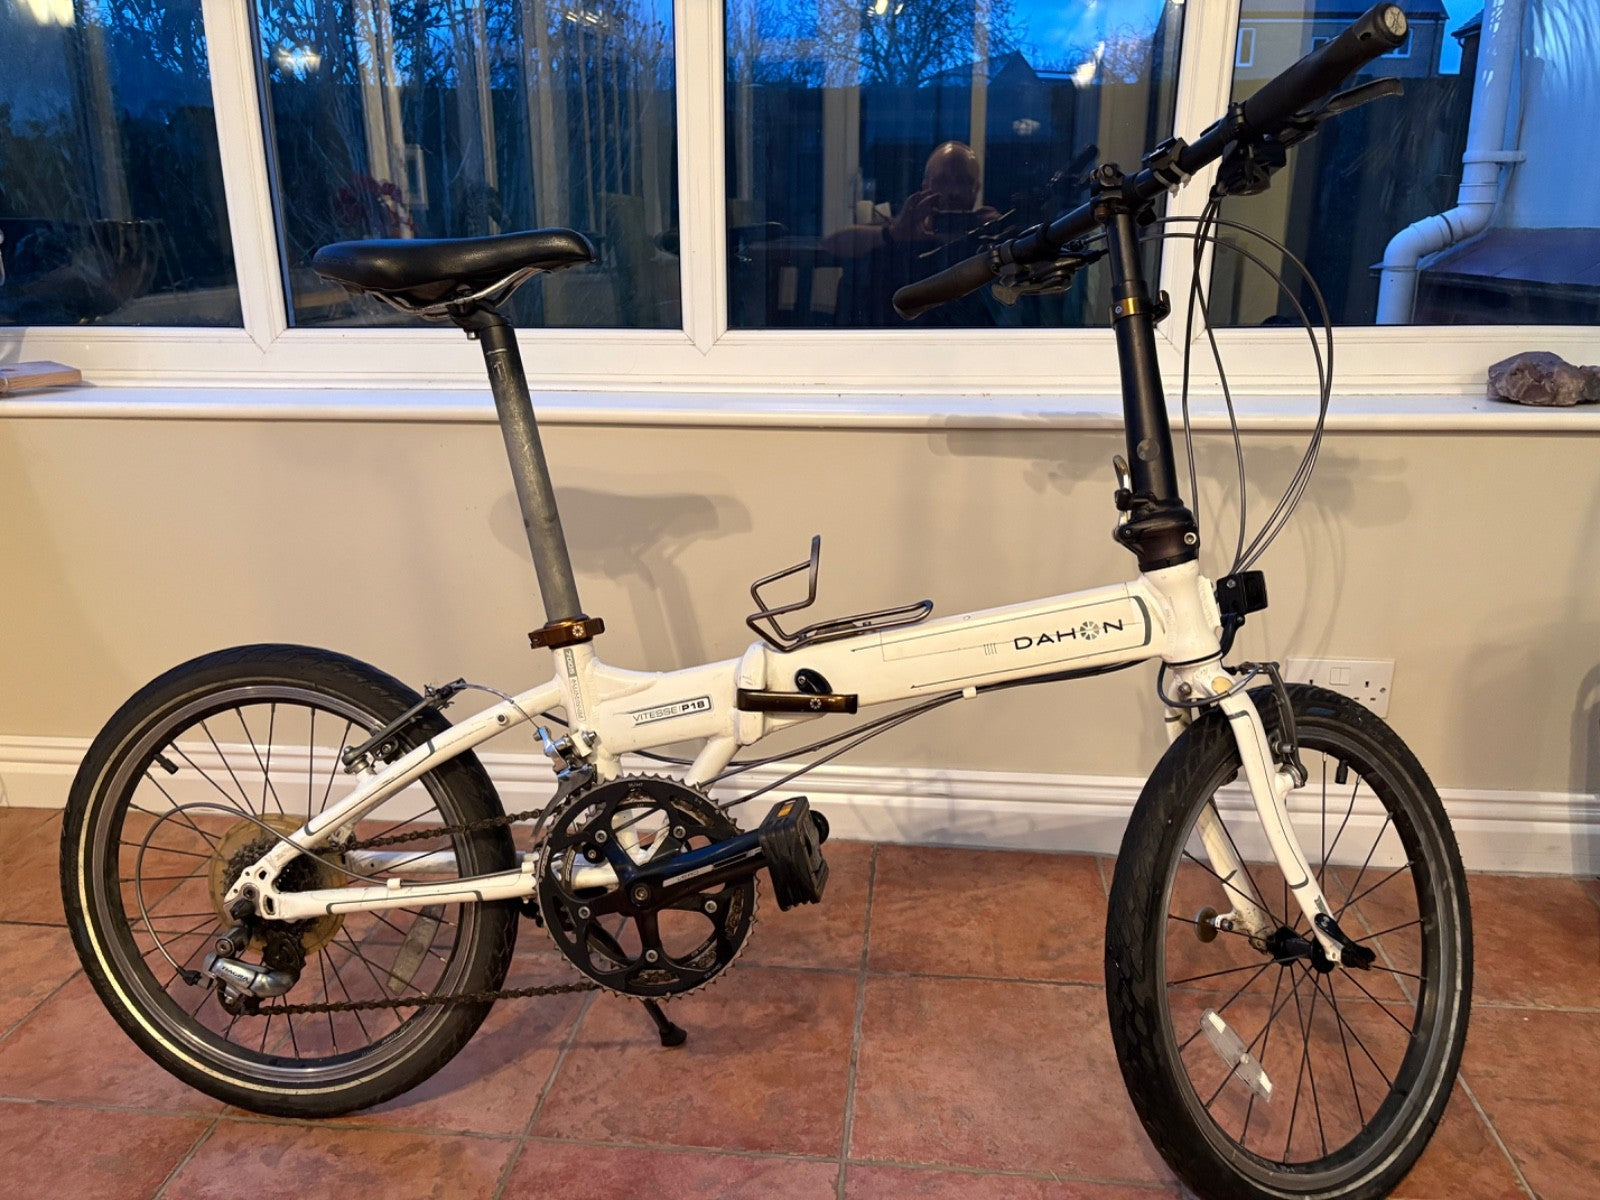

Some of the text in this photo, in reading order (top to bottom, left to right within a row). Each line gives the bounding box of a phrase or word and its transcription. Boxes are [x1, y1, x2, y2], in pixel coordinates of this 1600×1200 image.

[1014, 619, 1123, 650] DAHON
[632, 700, 705, 721] VITESSE P18
